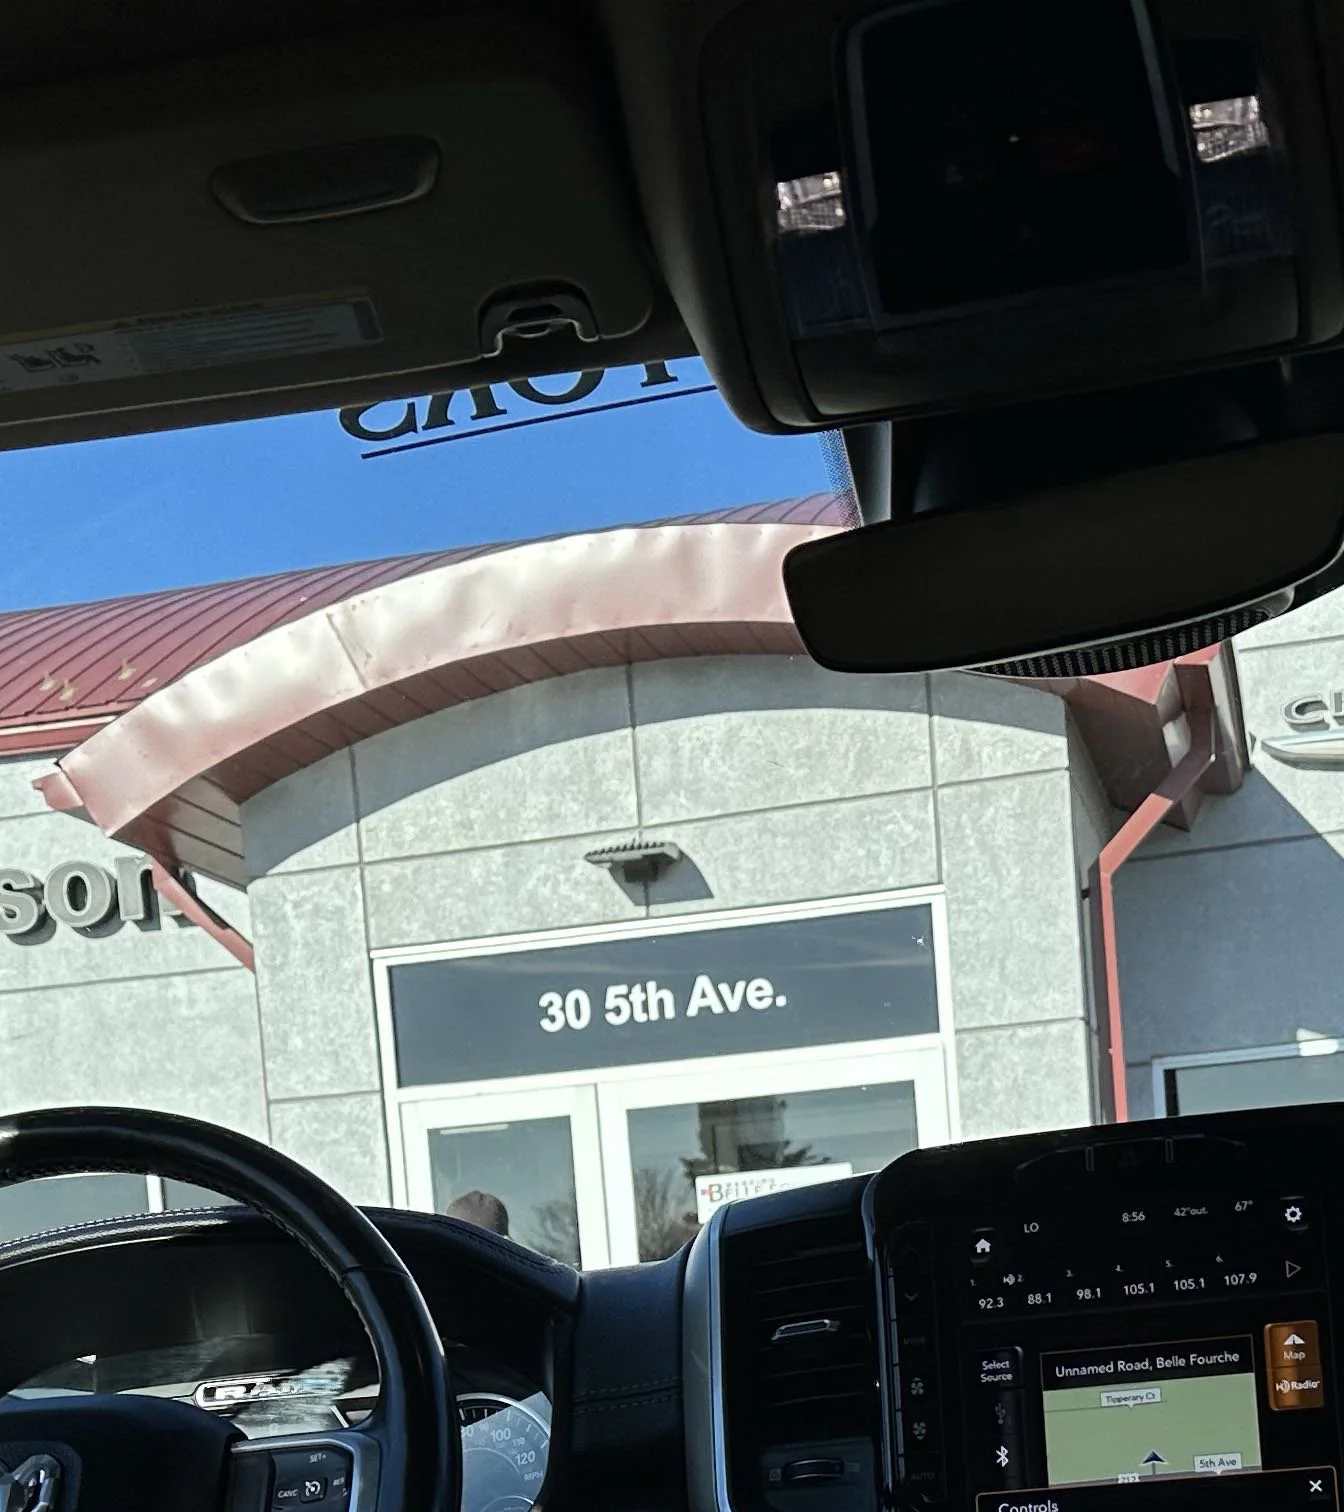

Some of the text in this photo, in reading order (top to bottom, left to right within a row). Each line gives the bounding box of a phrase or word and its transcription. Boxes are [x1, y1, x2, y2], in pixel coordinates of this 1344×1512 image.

[539, 975, 788, 1033] 30 5th Ave.
[1234, 1200, 1254, 1212] 67°
[1121, 1211, 1146, 1224] 8:56
[1024, 1222, 1039, 1234] LO
[1174, 1277, 1206, 1292] 105.1
[1223, 1272, 1257, 1287] 107.9
[1076, 1288, 1101, 1300] 98.1
[1123, 1282, 1155, 1296] 105.1
[978, 1297, 1005, 1310] 92.3
[1027, 1292, 1052, 1305] 88.1
[1283, 1351, 1306, 1361] Map
[981, 1360, 1010, 1371] Select
[1056, 1350, 1240, 1378] Unnamed Road, Belle Fourche
[980, 1372, 1013, 1383] Source
[491, 1428, 512, 1443] 100
[515, 1450, 536, 1466] 120
[1218, 1457, 1237, 1467] Ave
